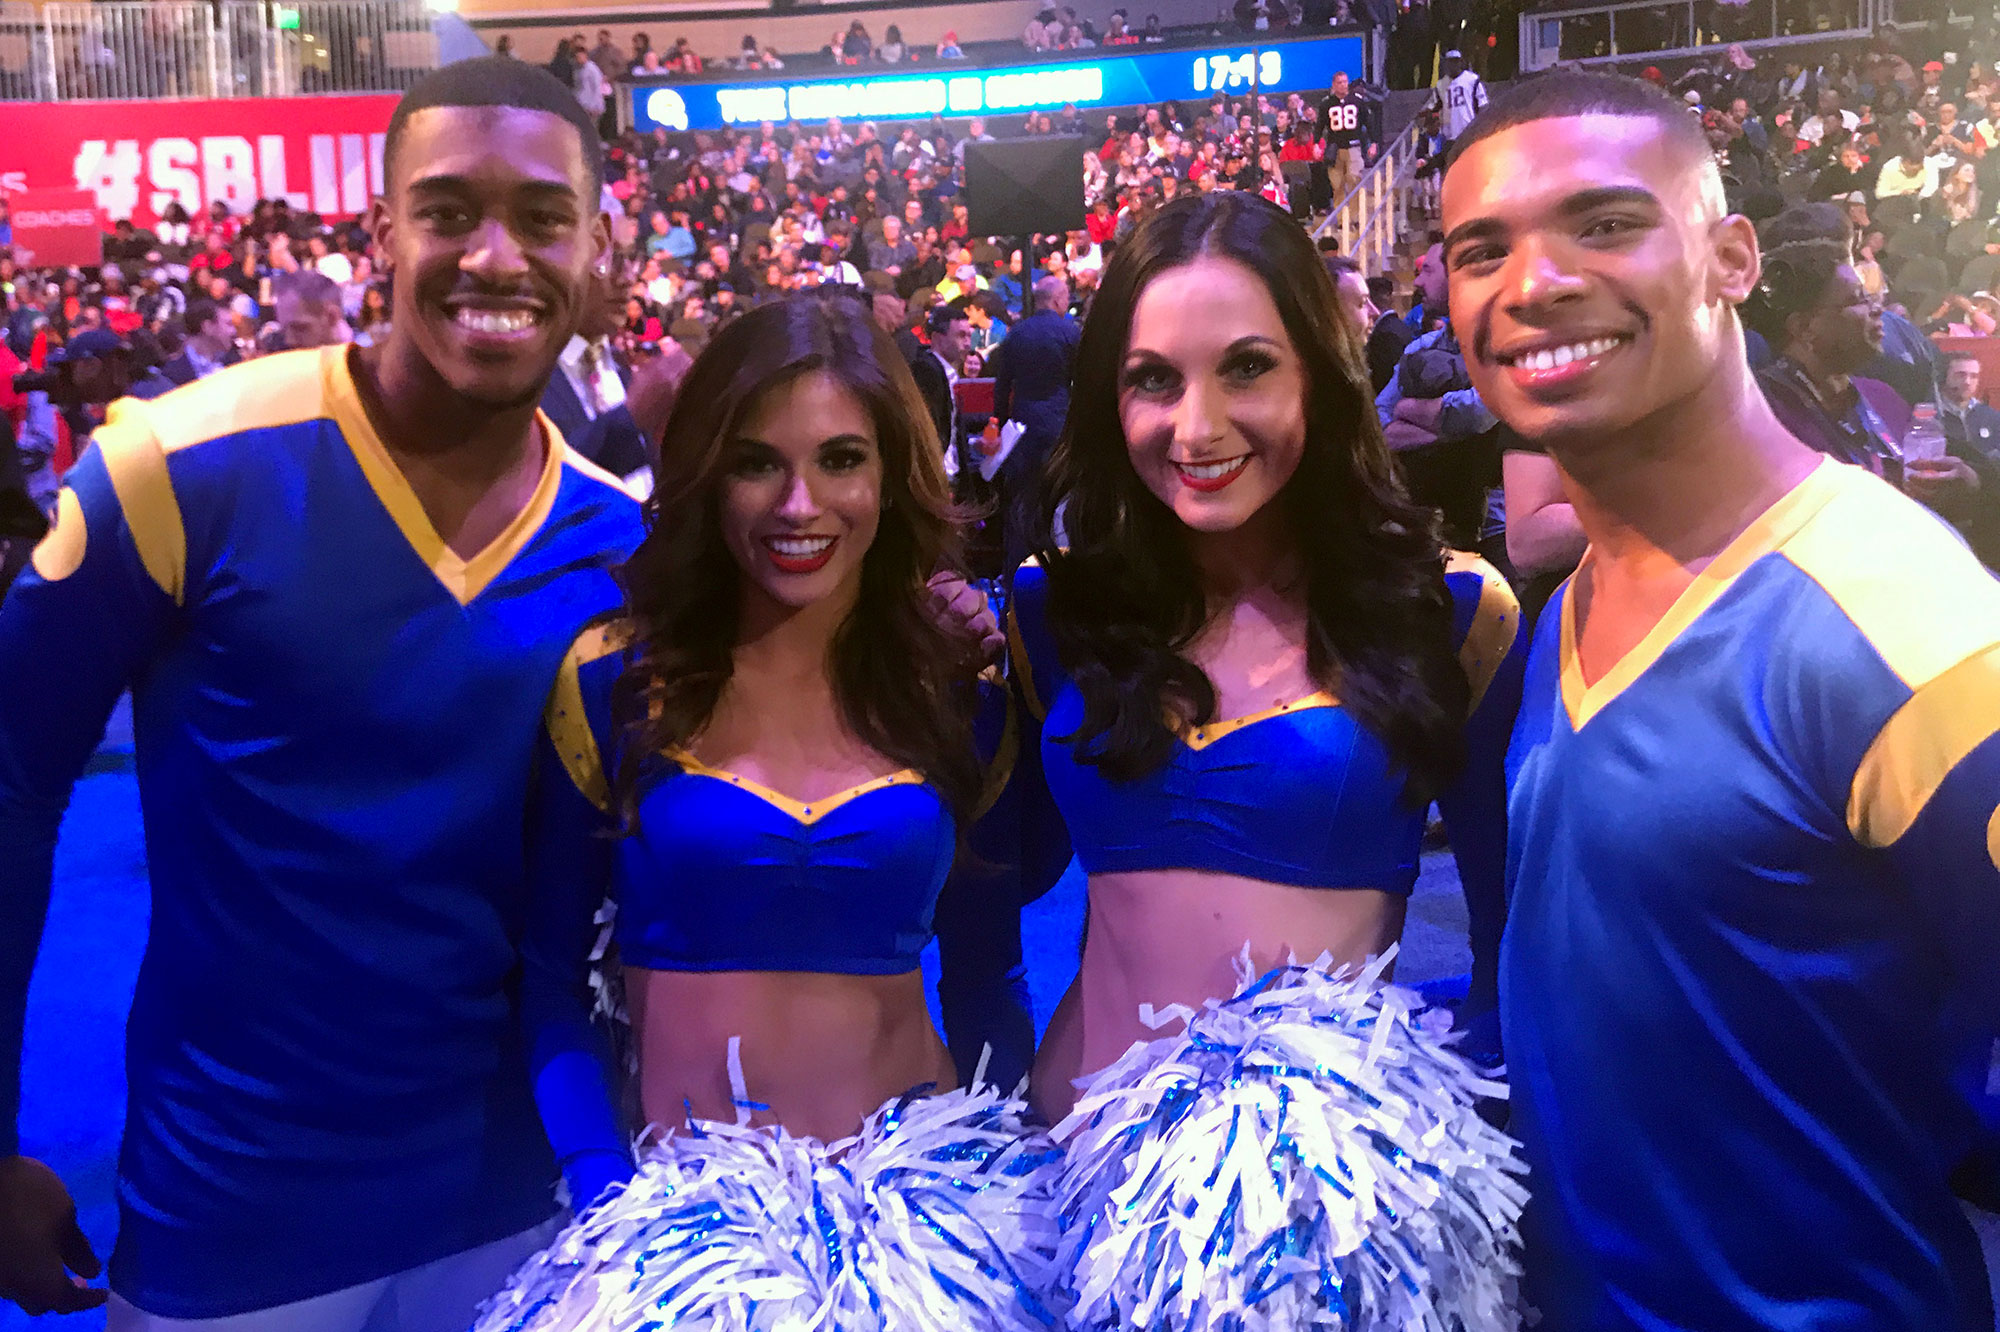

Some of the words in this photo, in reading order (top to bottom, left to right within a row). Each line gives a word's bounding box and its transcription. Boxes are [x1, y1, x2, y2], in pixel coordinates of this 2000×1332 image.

[1446, 85, 1465, 109] 12
[1328, 104, 1358, 131] 88
[12, 209, 95, 228] COACHES
